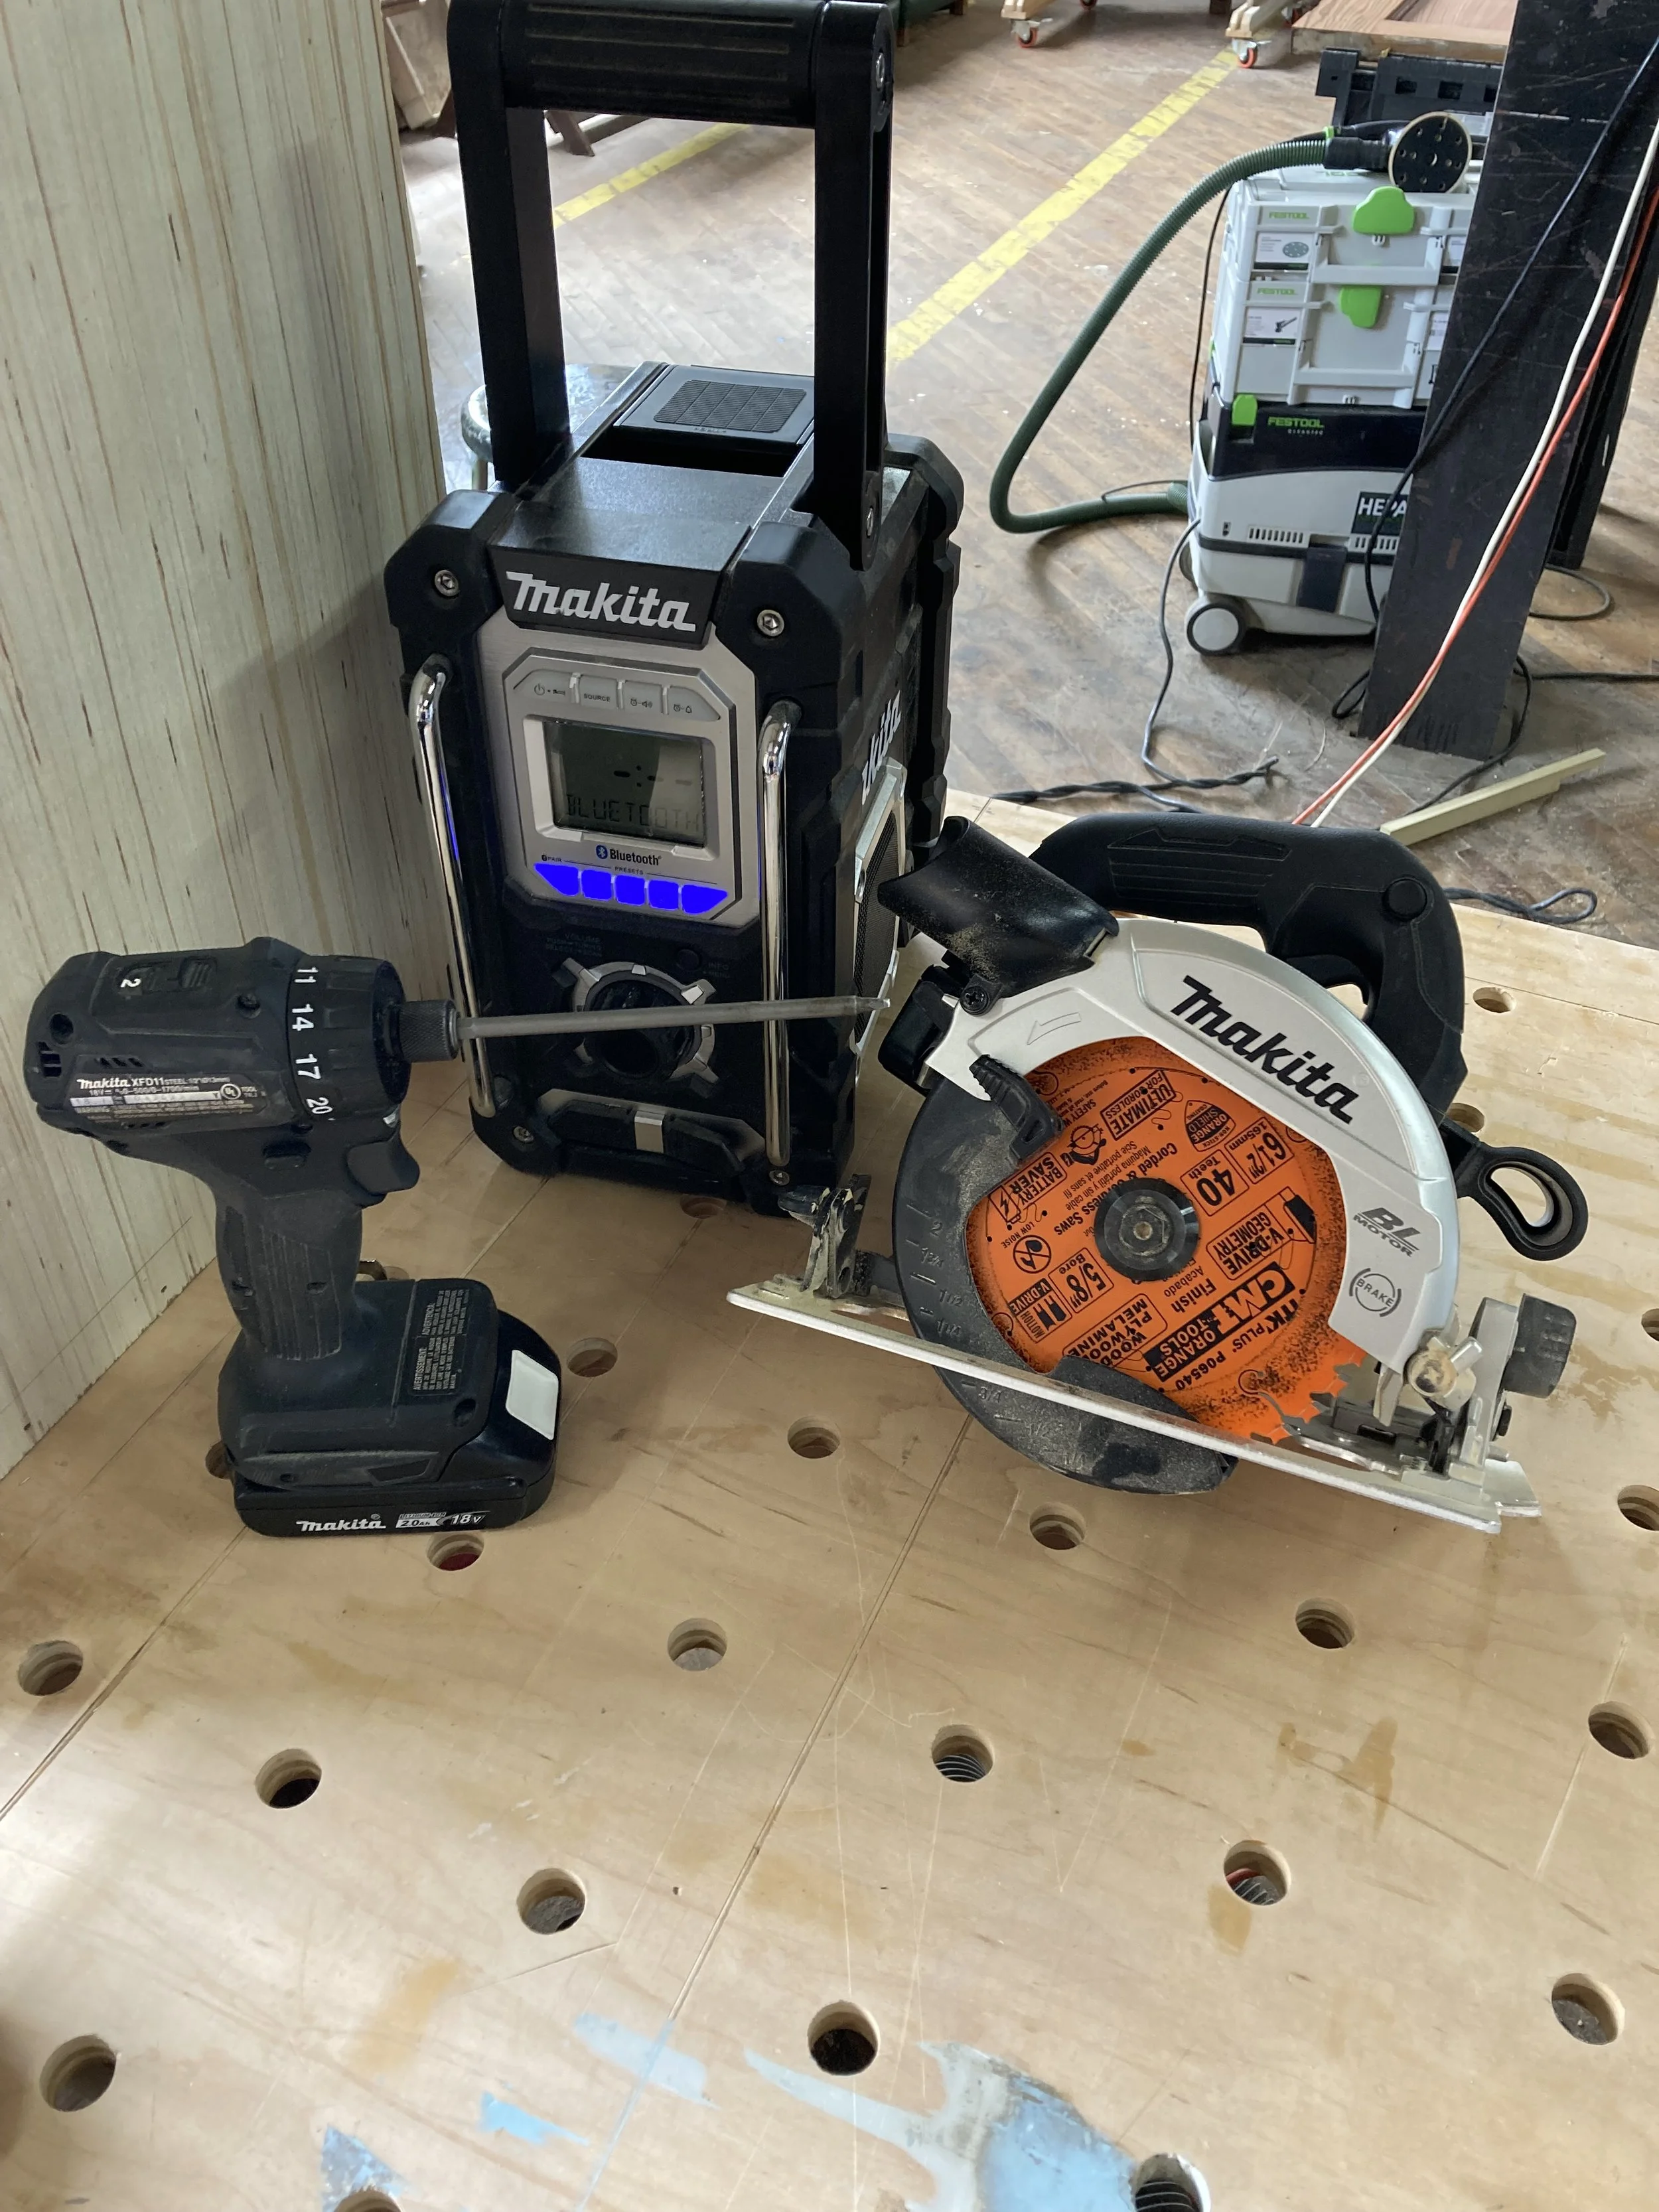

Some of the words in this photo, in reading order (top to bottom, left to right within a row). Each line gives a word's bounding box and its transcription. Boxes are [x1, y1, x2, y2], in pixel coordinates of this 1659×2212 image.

[1269, 211, 1310, 220] FESTOOL
[1268, 416, 1325, 428] FESTOOL
[583, 693, 611, 702] SOURCE
[614, 866, 644, 875] PRESETS
[120, 978, 141, 988] 2
[291, 1003, 315, 1031] 14
[295, 1053, 321, 1080] 17
[131, 1076, 164, 1086] XFD11
[1144, 1072, 1164, 1090] FOR
[305, 1096, 333, 1115] 20
[1070, 1098, 1096, 1121] SAFETY
[1108, 1082, 1173, 1136] ULTIMATE
[1188, 1108, 1218, 1132] SHIELD
[1190, 1114, 1226, 1142] ORANGE
[1120, 1140, 1137, 1153] Scie
[1200, 1124, 1232, 1149] NON-STICK
[1228, 1121, 1267, 1150] 165mm
[1092, 1149, 1121, 1174] portative
[1121, 1145, 1151, 1169] Máquina
[1137, 1142, 1177, 1175] Corded
[1188, 1156, 1220, 1179] Teeth
[1008, 1157, 1054, 1194] SAVER
[1017, 1166, 1062, 1205] BATTERY
[1070, 1177, 1086, 1191] sans
[1084, 1171, 1094, 1181] et
[1097, 1164, 1121, 1188] portátil
[1196, 1169, 1234, 1206] 40
[1062, 1189, 1072, 1199] fil
[1065, 1194, 1083, 1210] cable
[1082, 1187, 1094, 1197] sin
[1020, 1221, 1035, 1234] LOW
[1054, 1212, 1083, 1235] Saws
[1212, 1212, 1271, 1260] GEOMETRY
[1353, 1215, 1413, 1258] MOTOR
[1000, 1231, 1021, 1248] NOISE
[1222, 1227, 1284, 1274] V-DRIVE
[1058, 1253, 1086, 1274] Bore
[1163, 1266, 1203, 1297] Acabado
[1356, 1278, 1395, 1307] BRAKE
[1009, 1282, 1049, 1313] V-DRIVE
[1171, 1278, 1216, 1312] Finish
[1206, 1264, 1291, 1337] CMT
[1020, 1310, 1045, 1338] HOLLOW
[1067, 1297, 1148, 1361] MELAMINE
[1159, 1319, 1208, 1355] TOOLS
[1232, 1322, 1265, 1349] PLUS
[1098, 1329, 1147, 1368] WOOD
[1155, 1330, 1215, 1376] ORANGE
[412, 1347, 426, 1390] AVERTISSEMENT:
[1175, 1351, 1226, 1390] P06540
